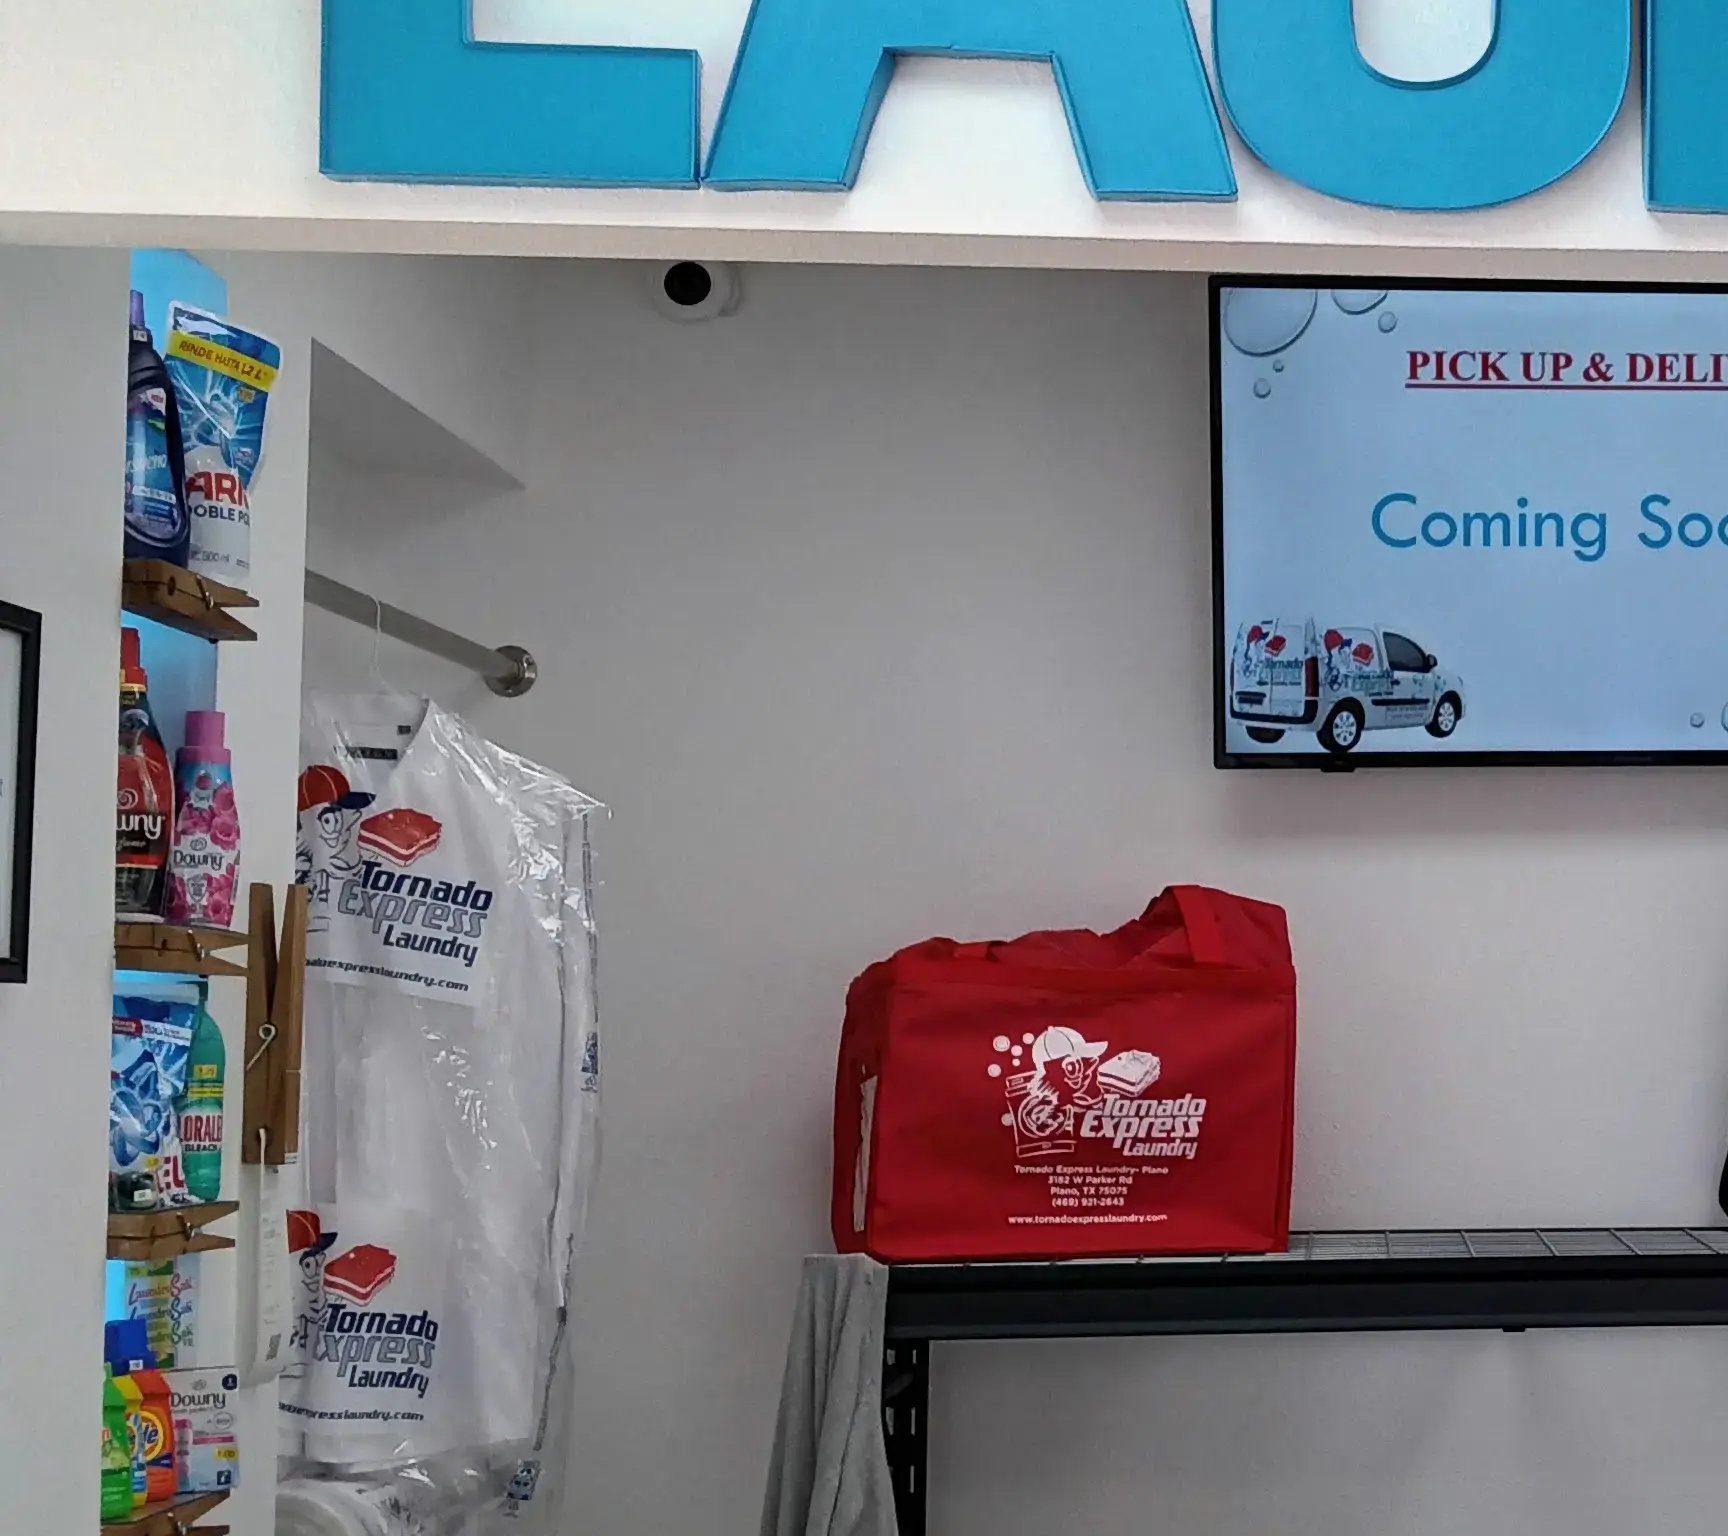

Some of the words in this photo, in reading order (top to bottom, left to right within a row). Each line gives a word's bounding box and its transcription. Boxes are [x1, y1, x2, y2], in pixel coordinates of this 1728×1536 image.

[1406, 350, 1506, 385] PICK
[1520, 352, 1573, 385] UP
[1582, 353, 1615, 385] &
[1371, 493, 1608, 562] Coming
[173, 850, 225, 871] Downy
[360, 860, 494, 912] Tornado
[337, 879, 488, 939] Express
[382, 924, 480, 967] Laundry
[1101, 1093, 1207, 1117] Tornado
[1080, 1112, 1203, 1148] Express
[1122, 1139, 1198, 1159] Laundry
[1014, 1165, 1054, 1174] Tornado
[1056, 1165, 1094, 1174] Express
[1096, 1165, 1140, 1174] Laundry-
[1142, 1166, 1169, 1174] Plano
[1048, 1176, 1070, 1184] 3182
[1073, 1176, 1083, 1184] W
[1086, 1175, 1116, 1184] Parker
[1119, 1176, 1133, 1184] Rd
[1051, 1187, 1080, 1196] Plano,
[1083, 1187, 1096, 1195] TX
[1098, 1187, 1128, 1195] 75075
[1052, 1197, 1079, 1207] (469)
[1081, 1197, 1125, 1207] 921-2643
[1008, 1214, 1168, 1224] www.tornadoexpresslaundry.com
[324, 1302, 439, 1342] Tornado
[348, 1366, 429, 1399] Laundry
[170, 1392, 226, 1409] Downy
